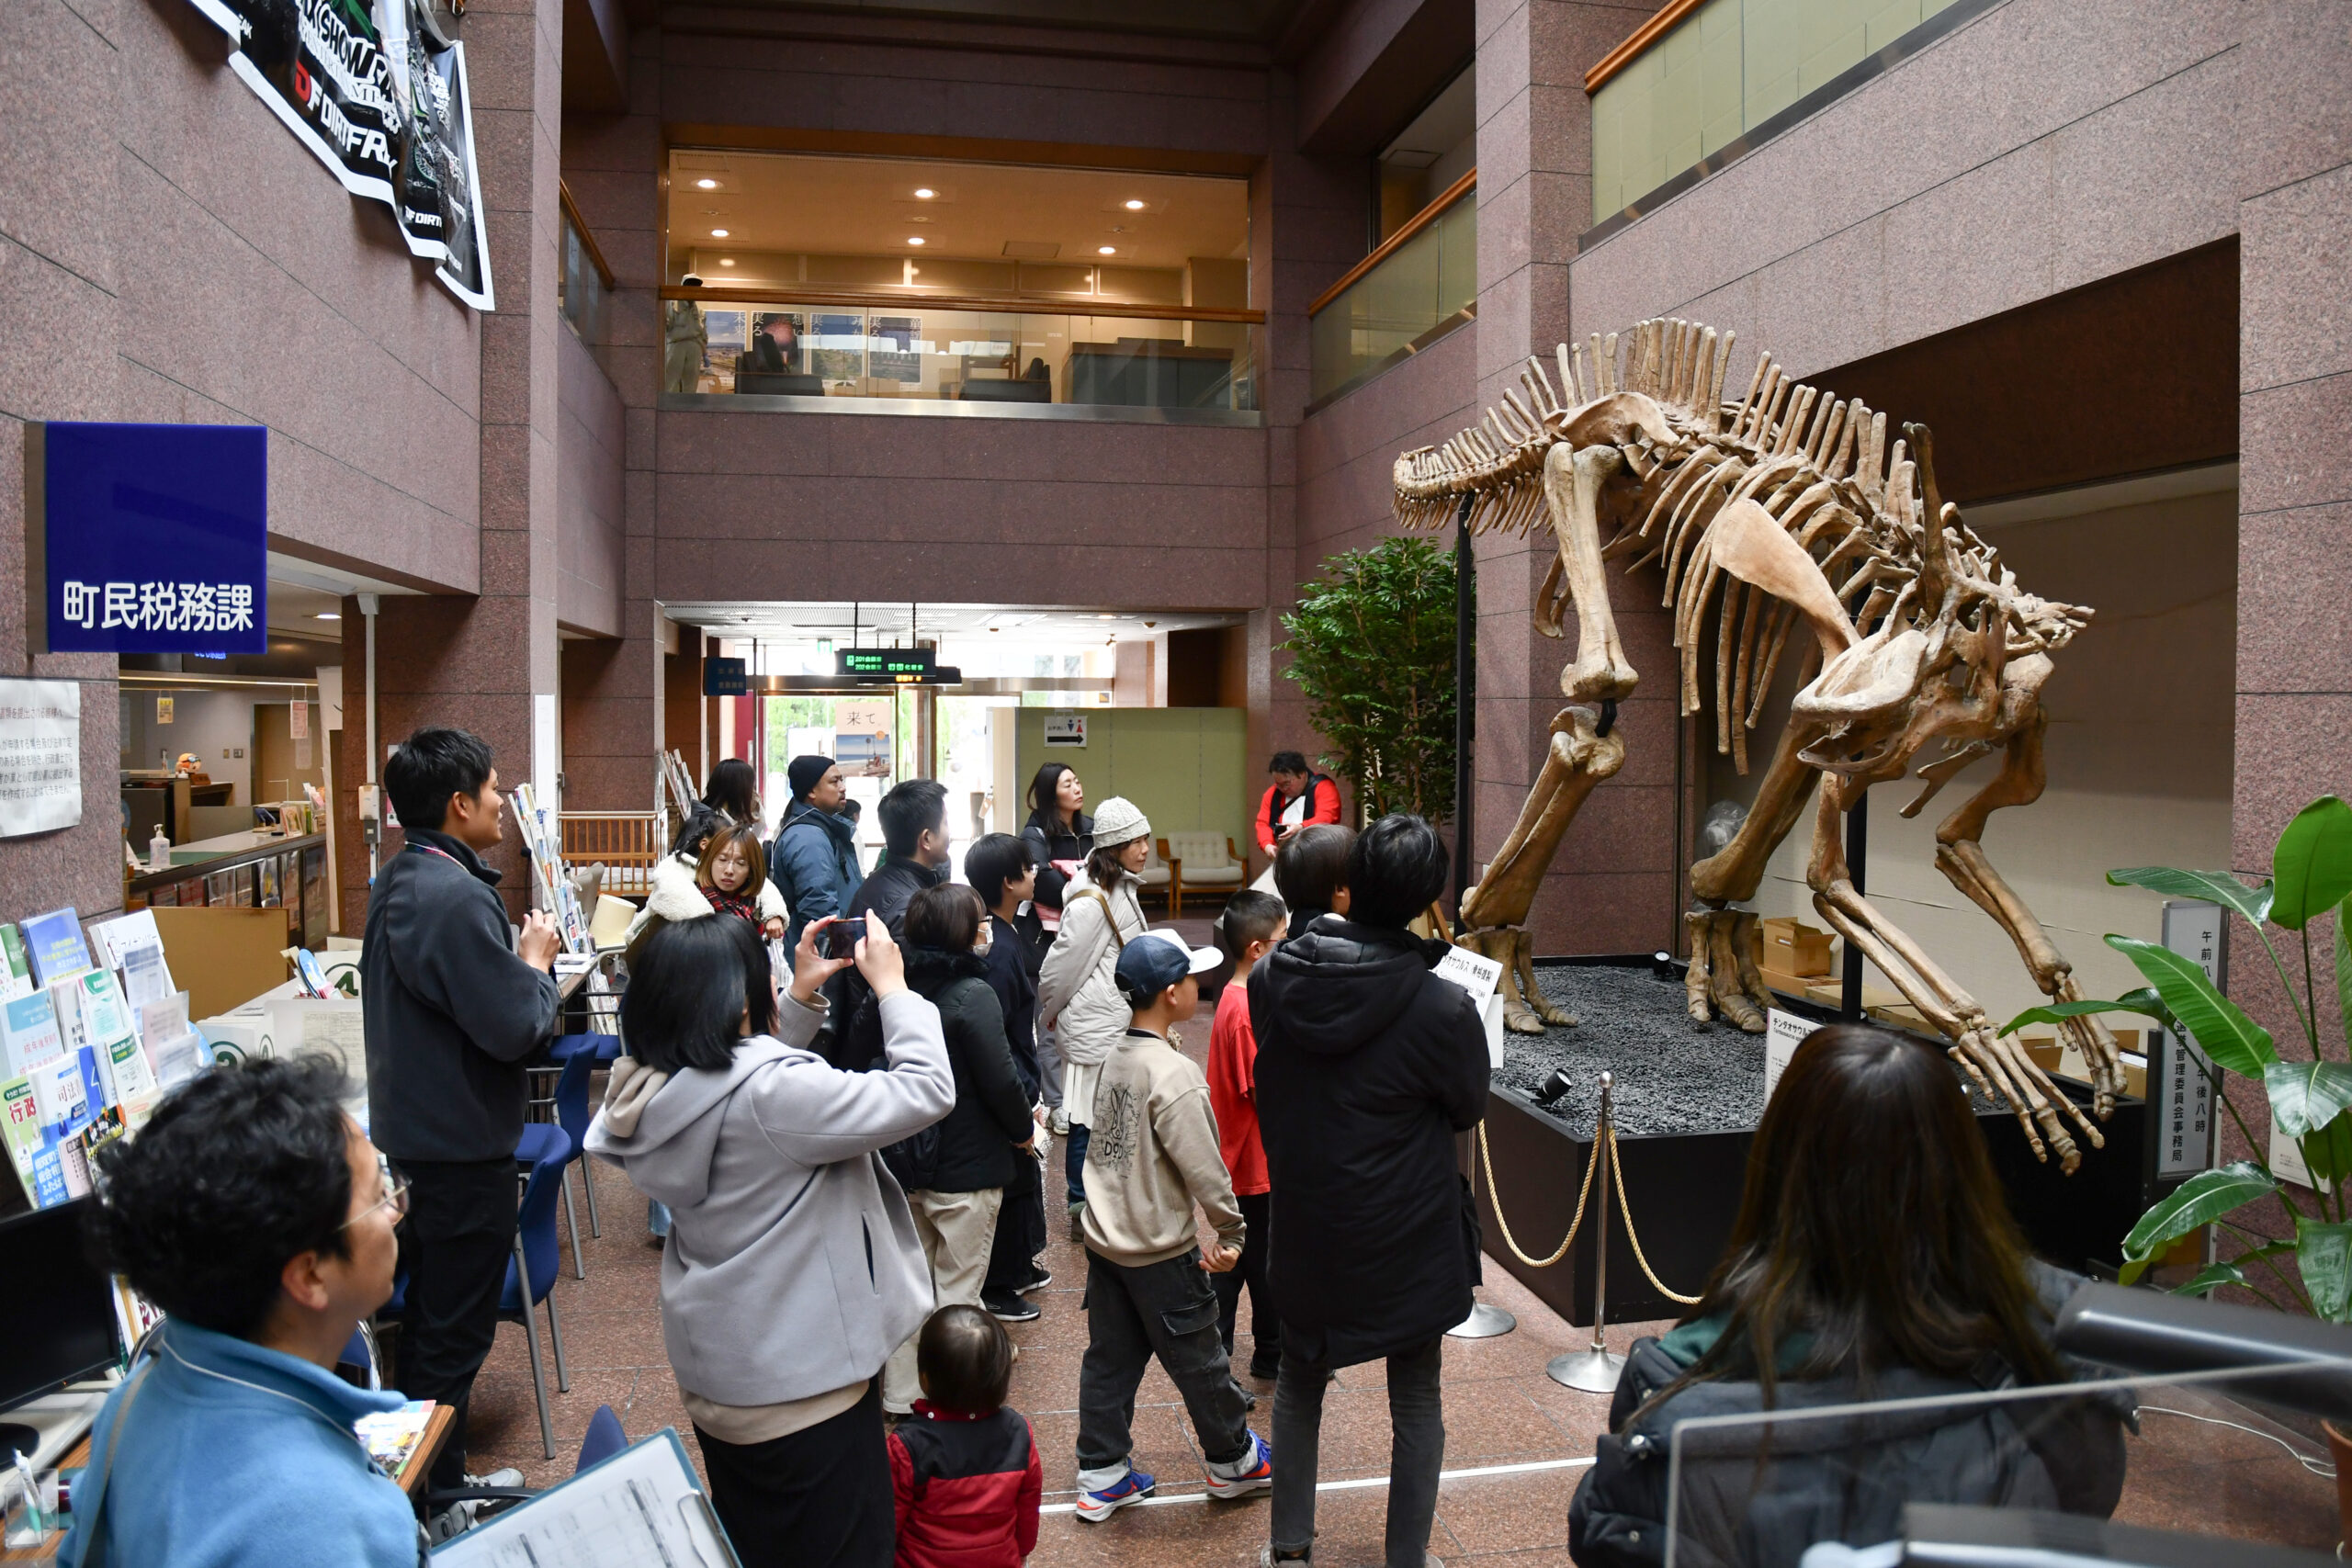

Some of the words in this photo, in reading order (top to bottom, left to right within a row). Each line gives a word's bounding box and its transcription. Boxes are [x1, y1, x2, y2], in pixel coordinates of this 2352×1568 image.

[63, 581, 254, 632] 町民税務課
